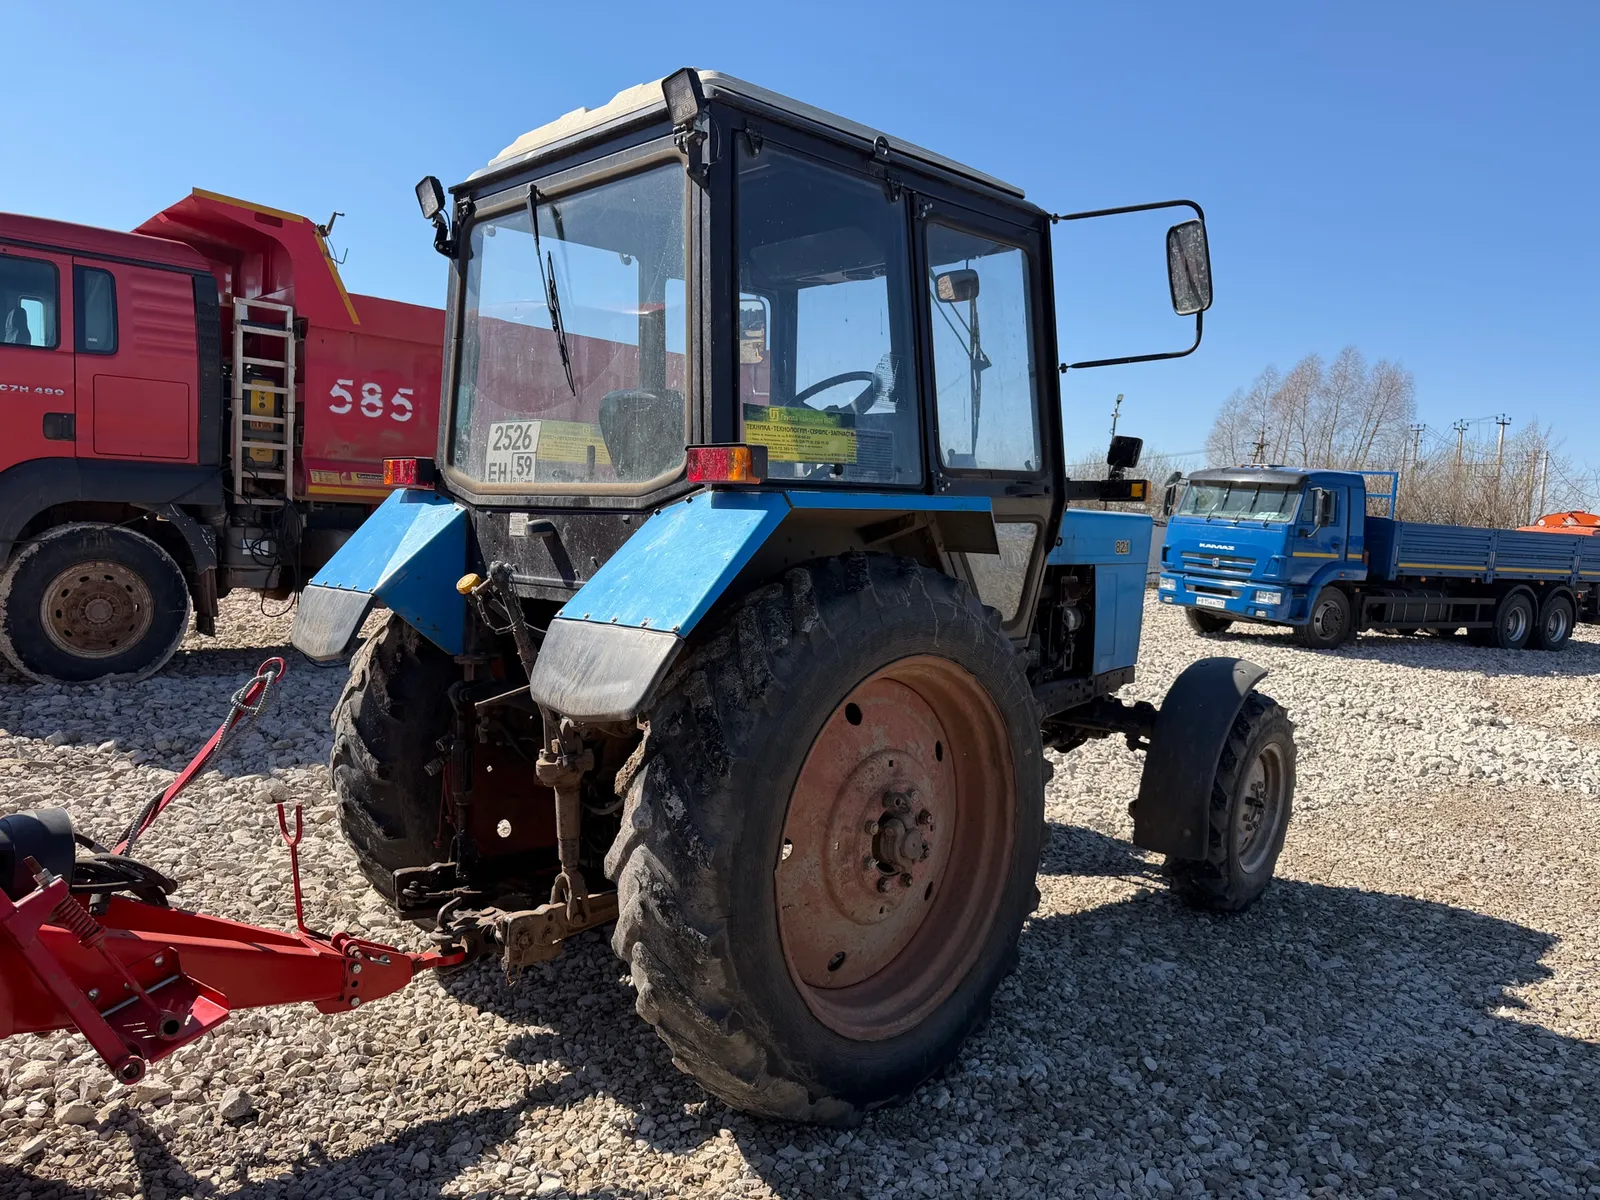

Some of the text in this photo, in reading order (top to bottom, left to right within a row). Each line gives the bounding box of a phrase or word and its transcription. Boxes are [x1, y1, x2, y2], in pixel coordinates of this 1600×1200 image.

[0, 383, 65, 396] C7H 480
[329, 379, 413, 422] 585
[746, 423, 771, 431] ТЕХНИКА
[493, 424, 532, 451] 2526
[516, 456, 532, 476] 59
[1199, 543, 1235, 551] KAMAZ
